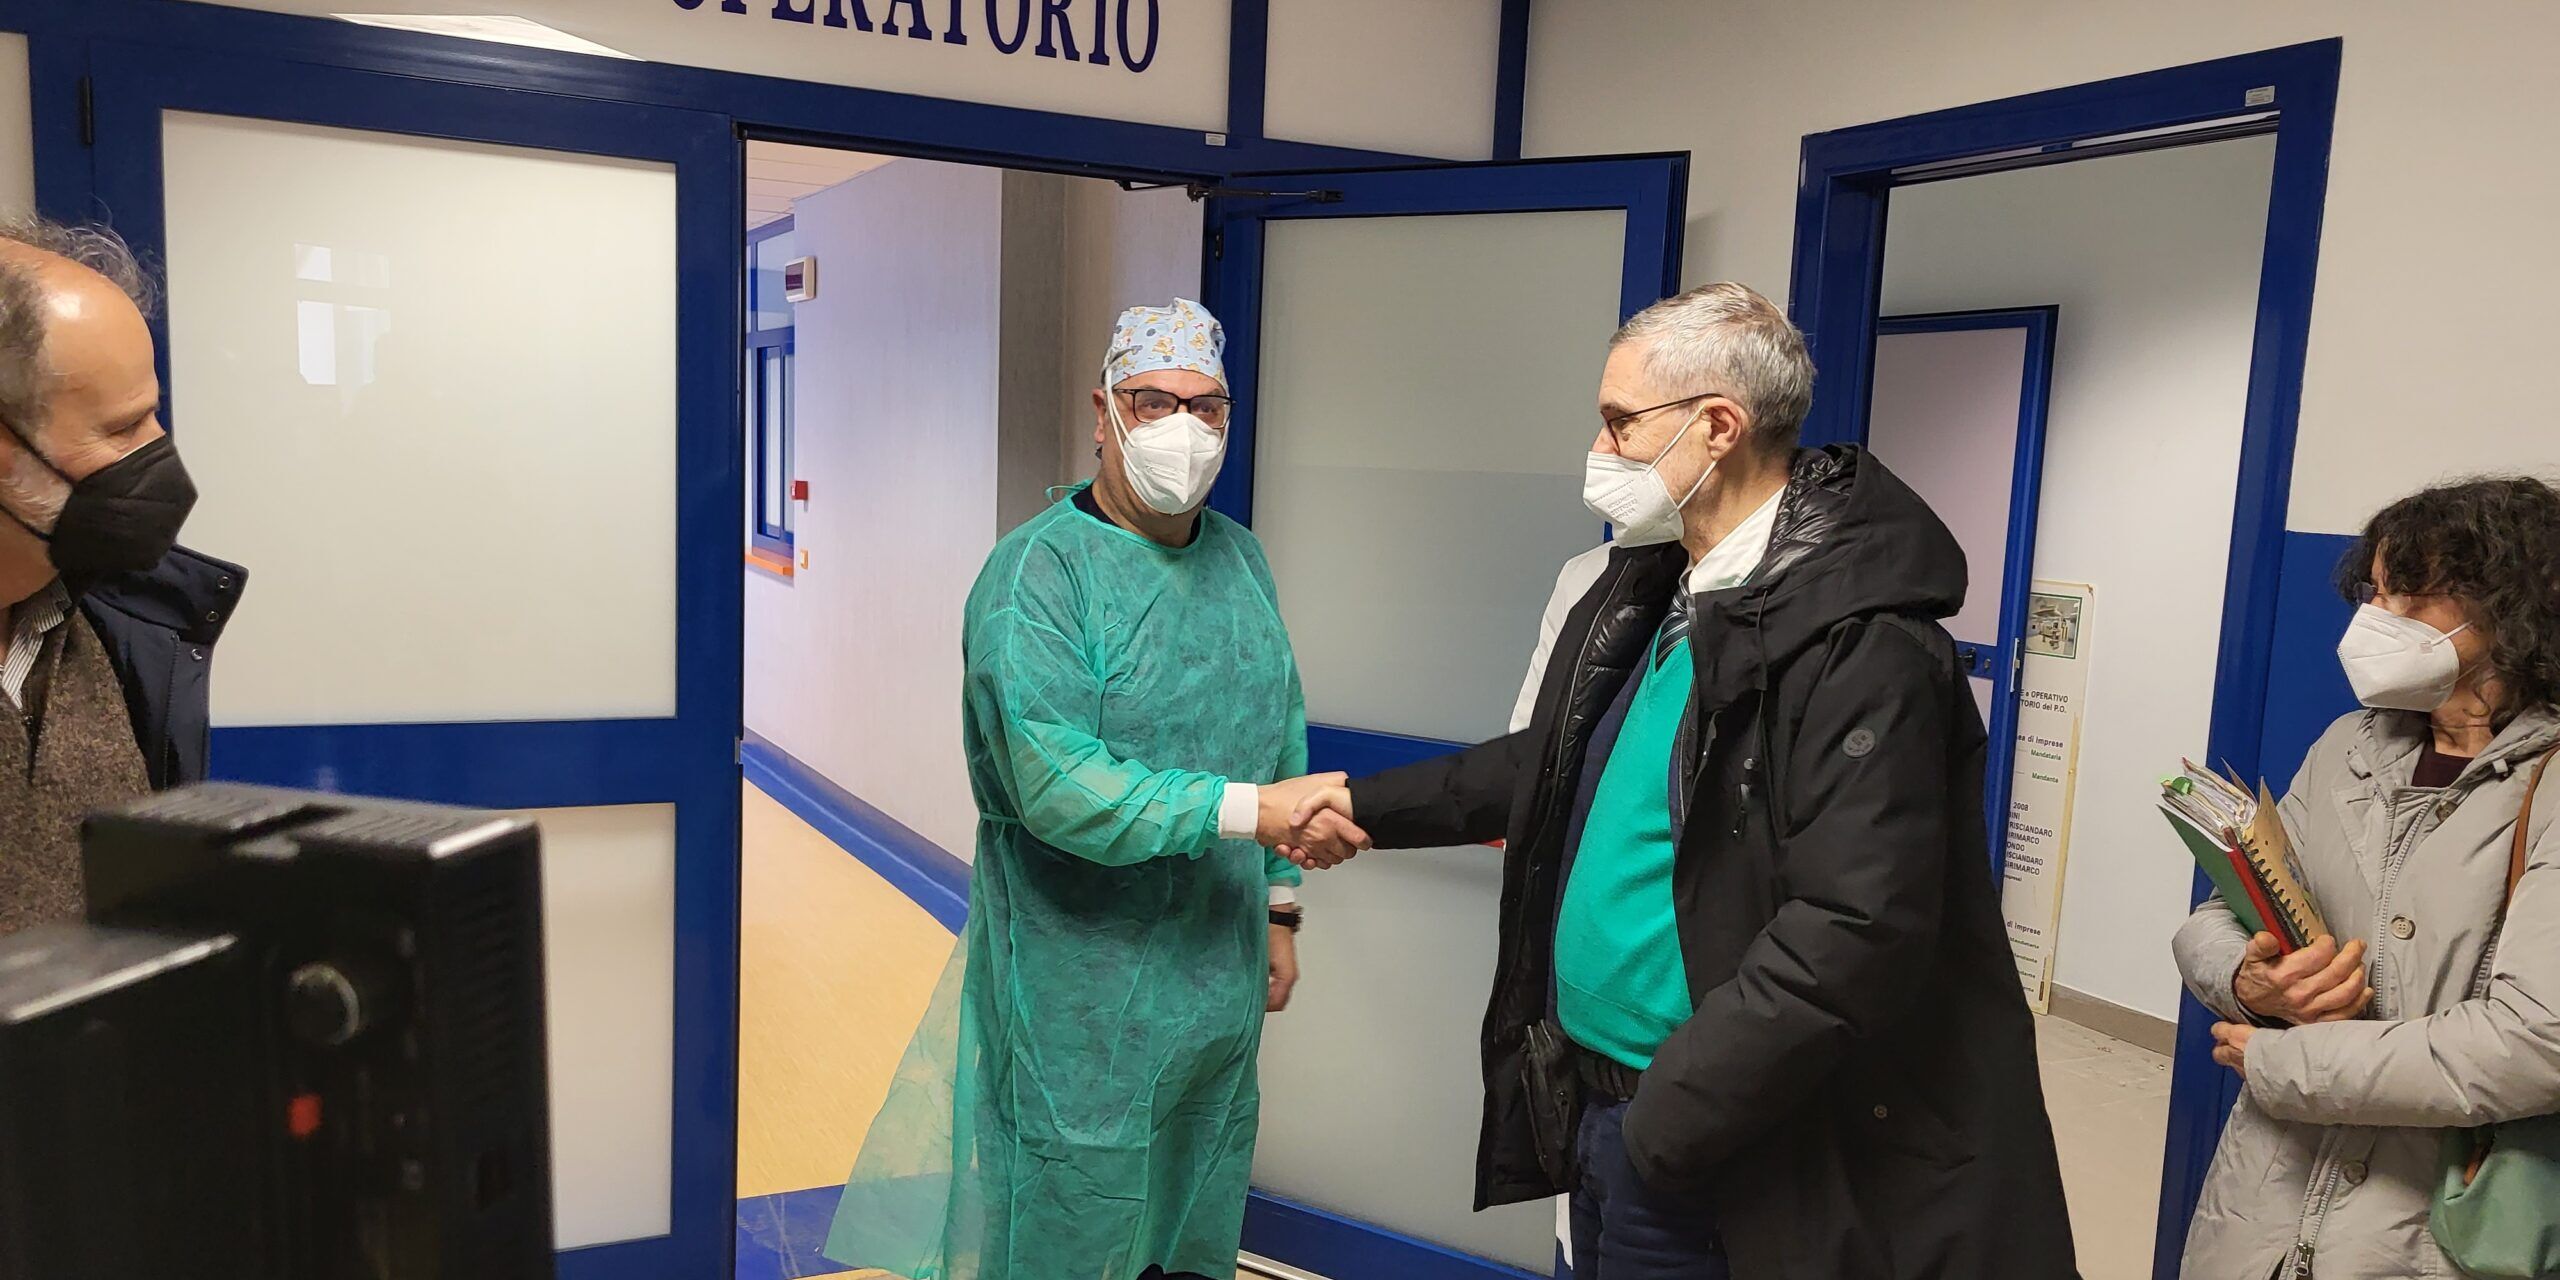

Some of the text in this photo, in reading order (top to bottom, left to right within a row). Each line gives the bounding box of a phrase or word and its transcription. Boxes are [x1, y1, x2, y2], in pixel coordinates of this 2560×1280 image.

[673, 0, 1159, 72] TORIO
[2031, 690, 2069, 703] OPERATIVO
[2042, 703, 2053, 711] del
[2054, 704, 2067, 714] P.O.
[2013, 802, 2029, 811] 2008
[2007, 920, 2013, 929] di
